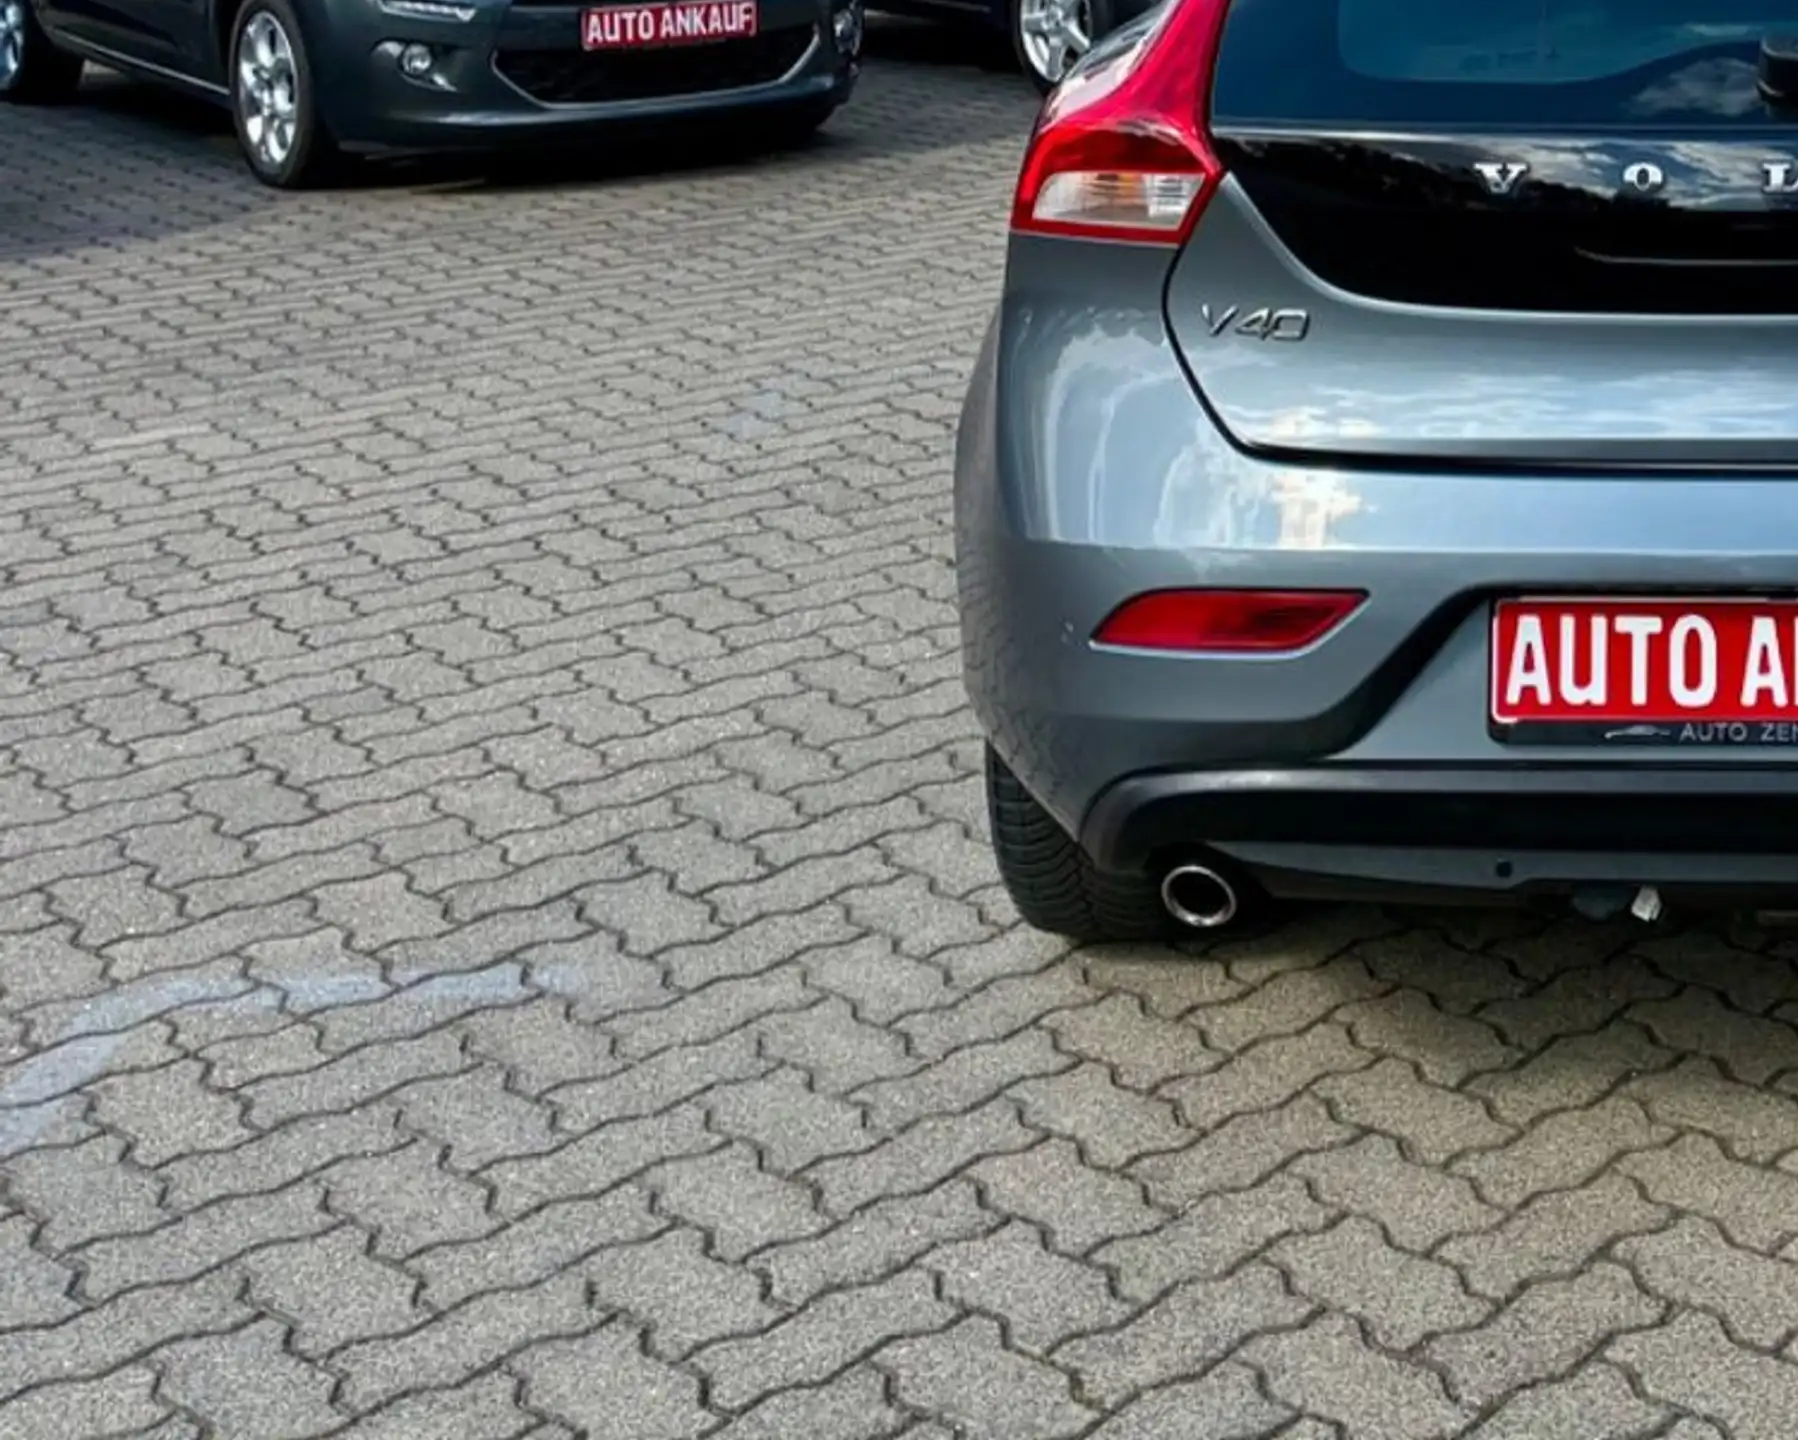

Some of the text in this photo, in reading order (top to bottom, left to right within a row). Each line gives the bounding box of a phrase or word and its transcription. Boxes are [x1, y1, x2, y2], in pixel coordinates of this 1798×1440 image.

[587, 1, 754, 44] AUTO ANKAUF
[1201, 303, 1311, 342] V40
[1506, 614, 1717, 707] AUTO
[1679, 722, 1748, 743] AUTO
